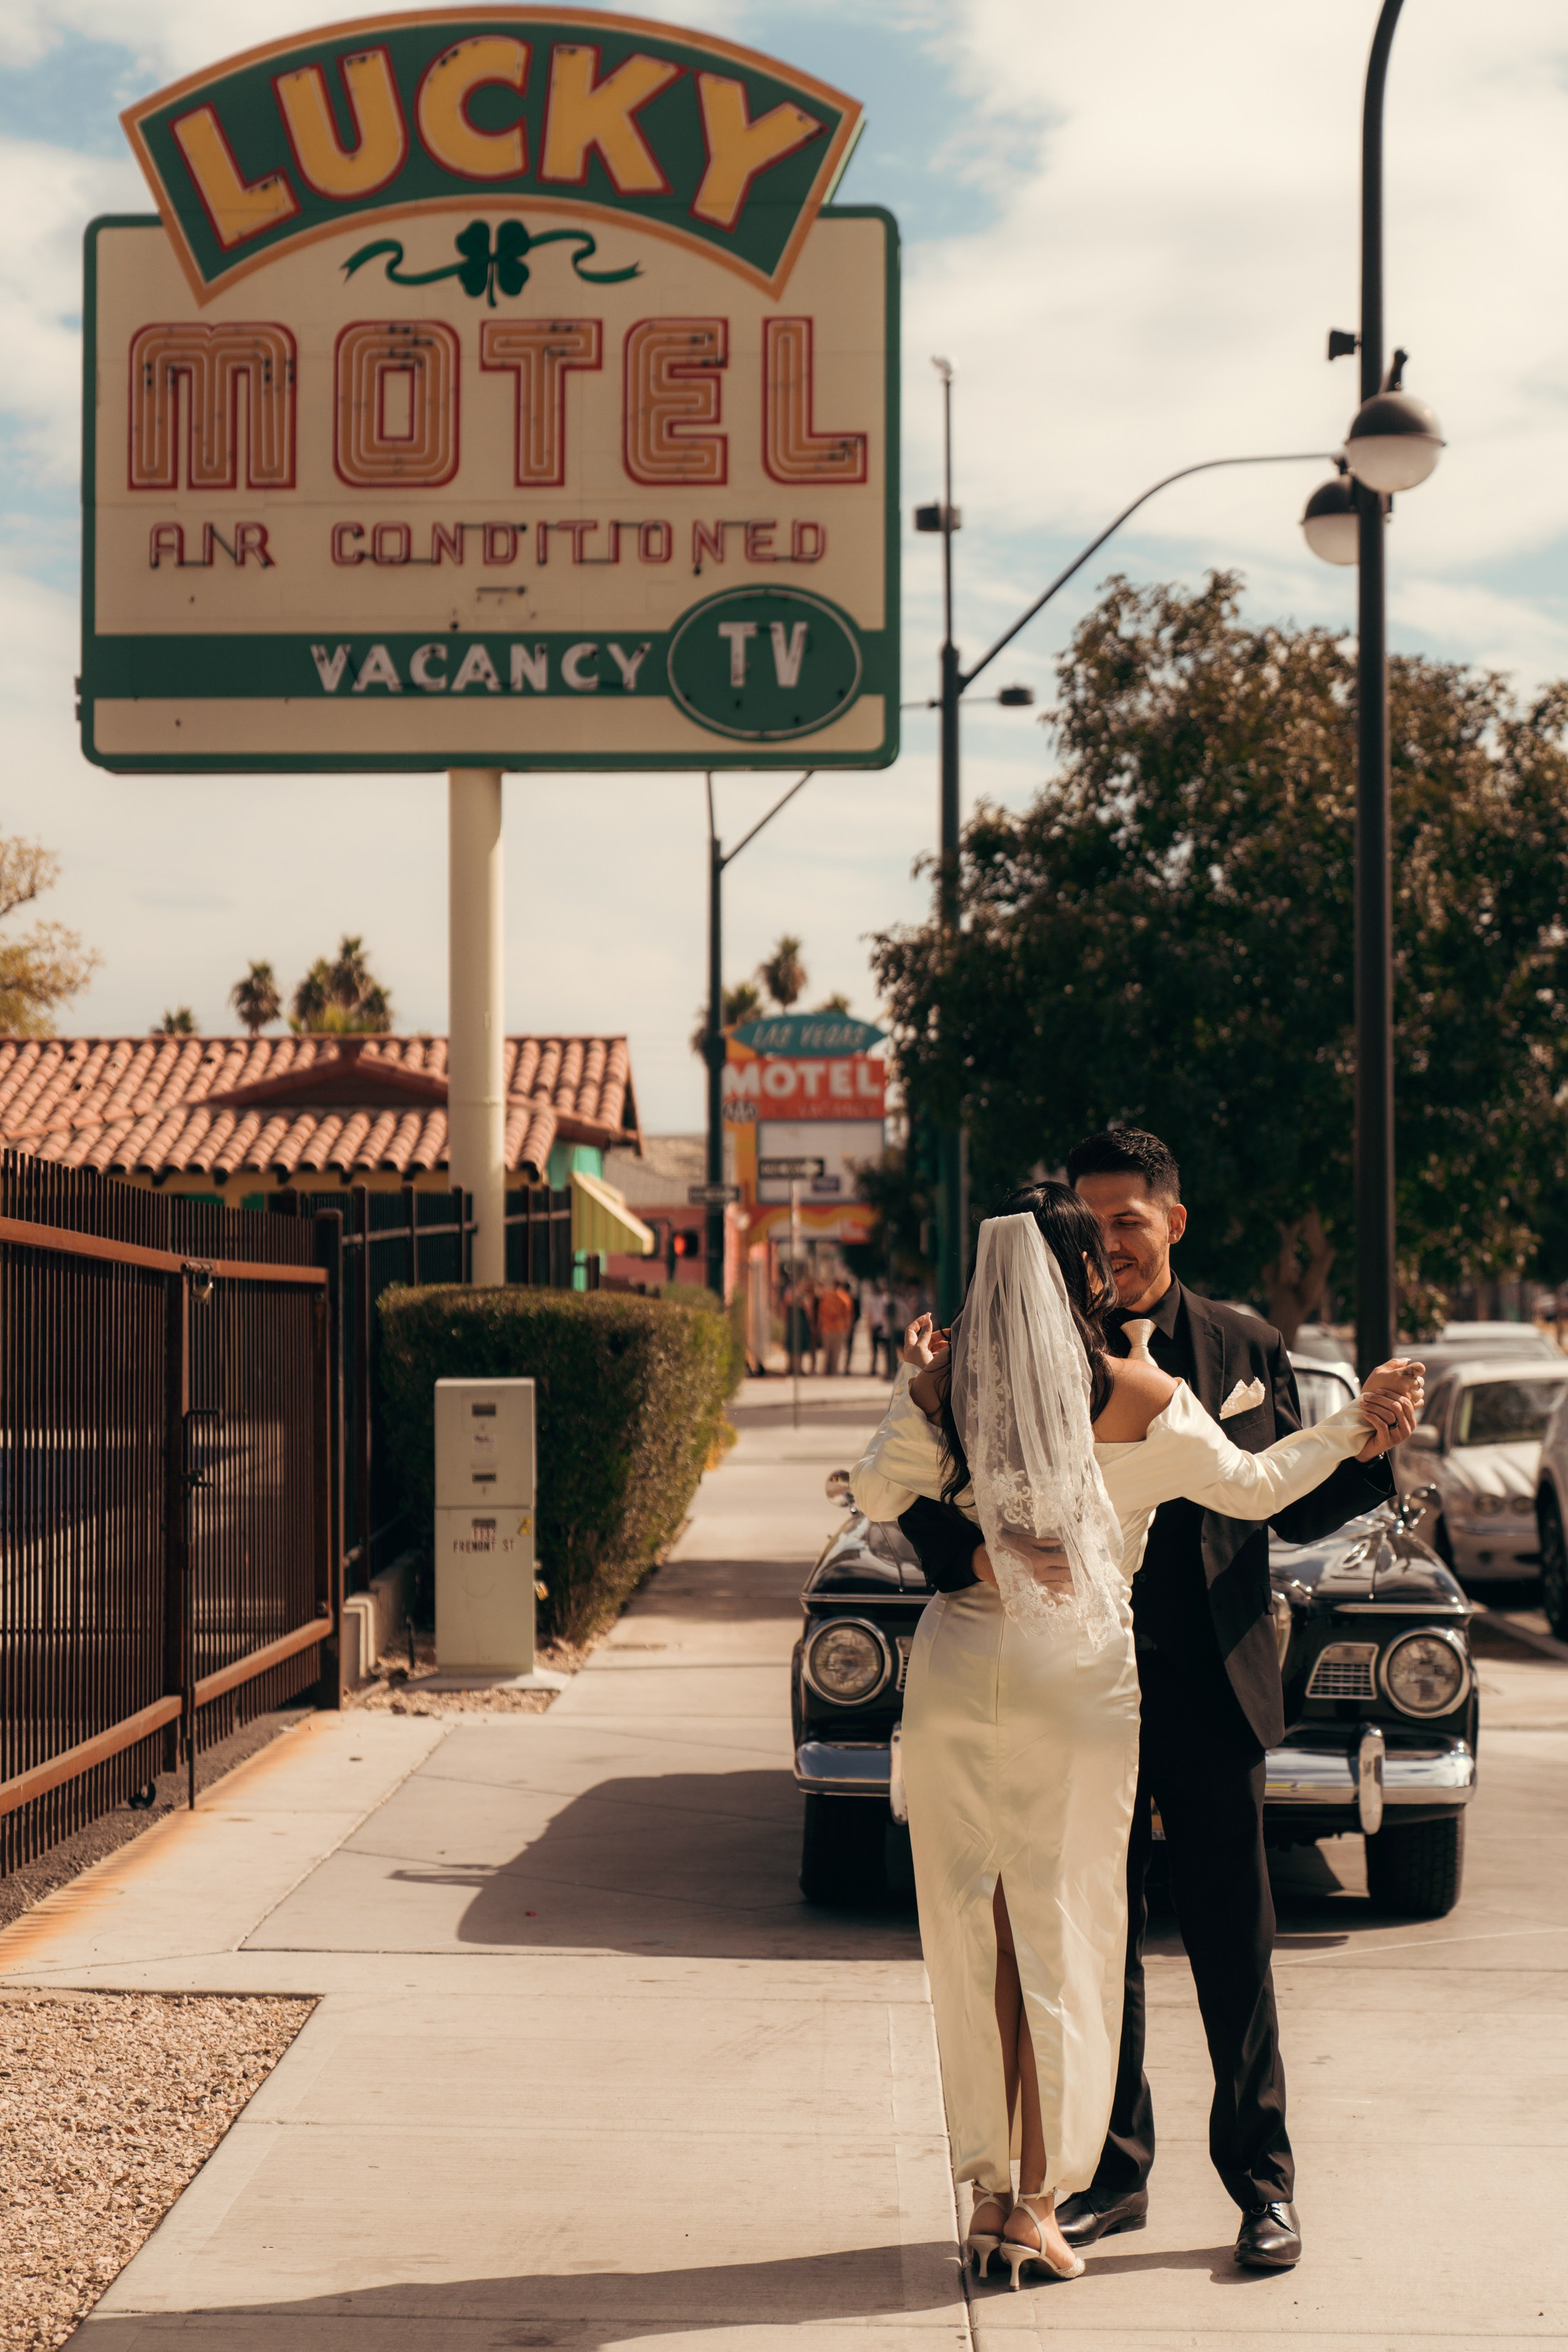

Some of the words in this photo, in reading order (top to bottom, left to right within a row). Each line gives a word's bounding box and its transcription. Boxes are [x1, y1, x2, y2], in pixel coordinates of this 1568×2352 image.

[170, 35, 828, 254] LUCKY
[128, 316, 867, 490] MOTEL
[149, 521, 275, 567] AIR
[331, 519, 827, 566] CONDITIONED
[310, 643, 651, 693] VACANCY
[717, 621, 809, 688] TV
[751, 1022, 794, 1048] LAS
[799, 1021, 867, 1049] VEGAS
[722, 1063, 881, 1098] MOTEL
[453, 1539, 496, 1553] FREMONT
